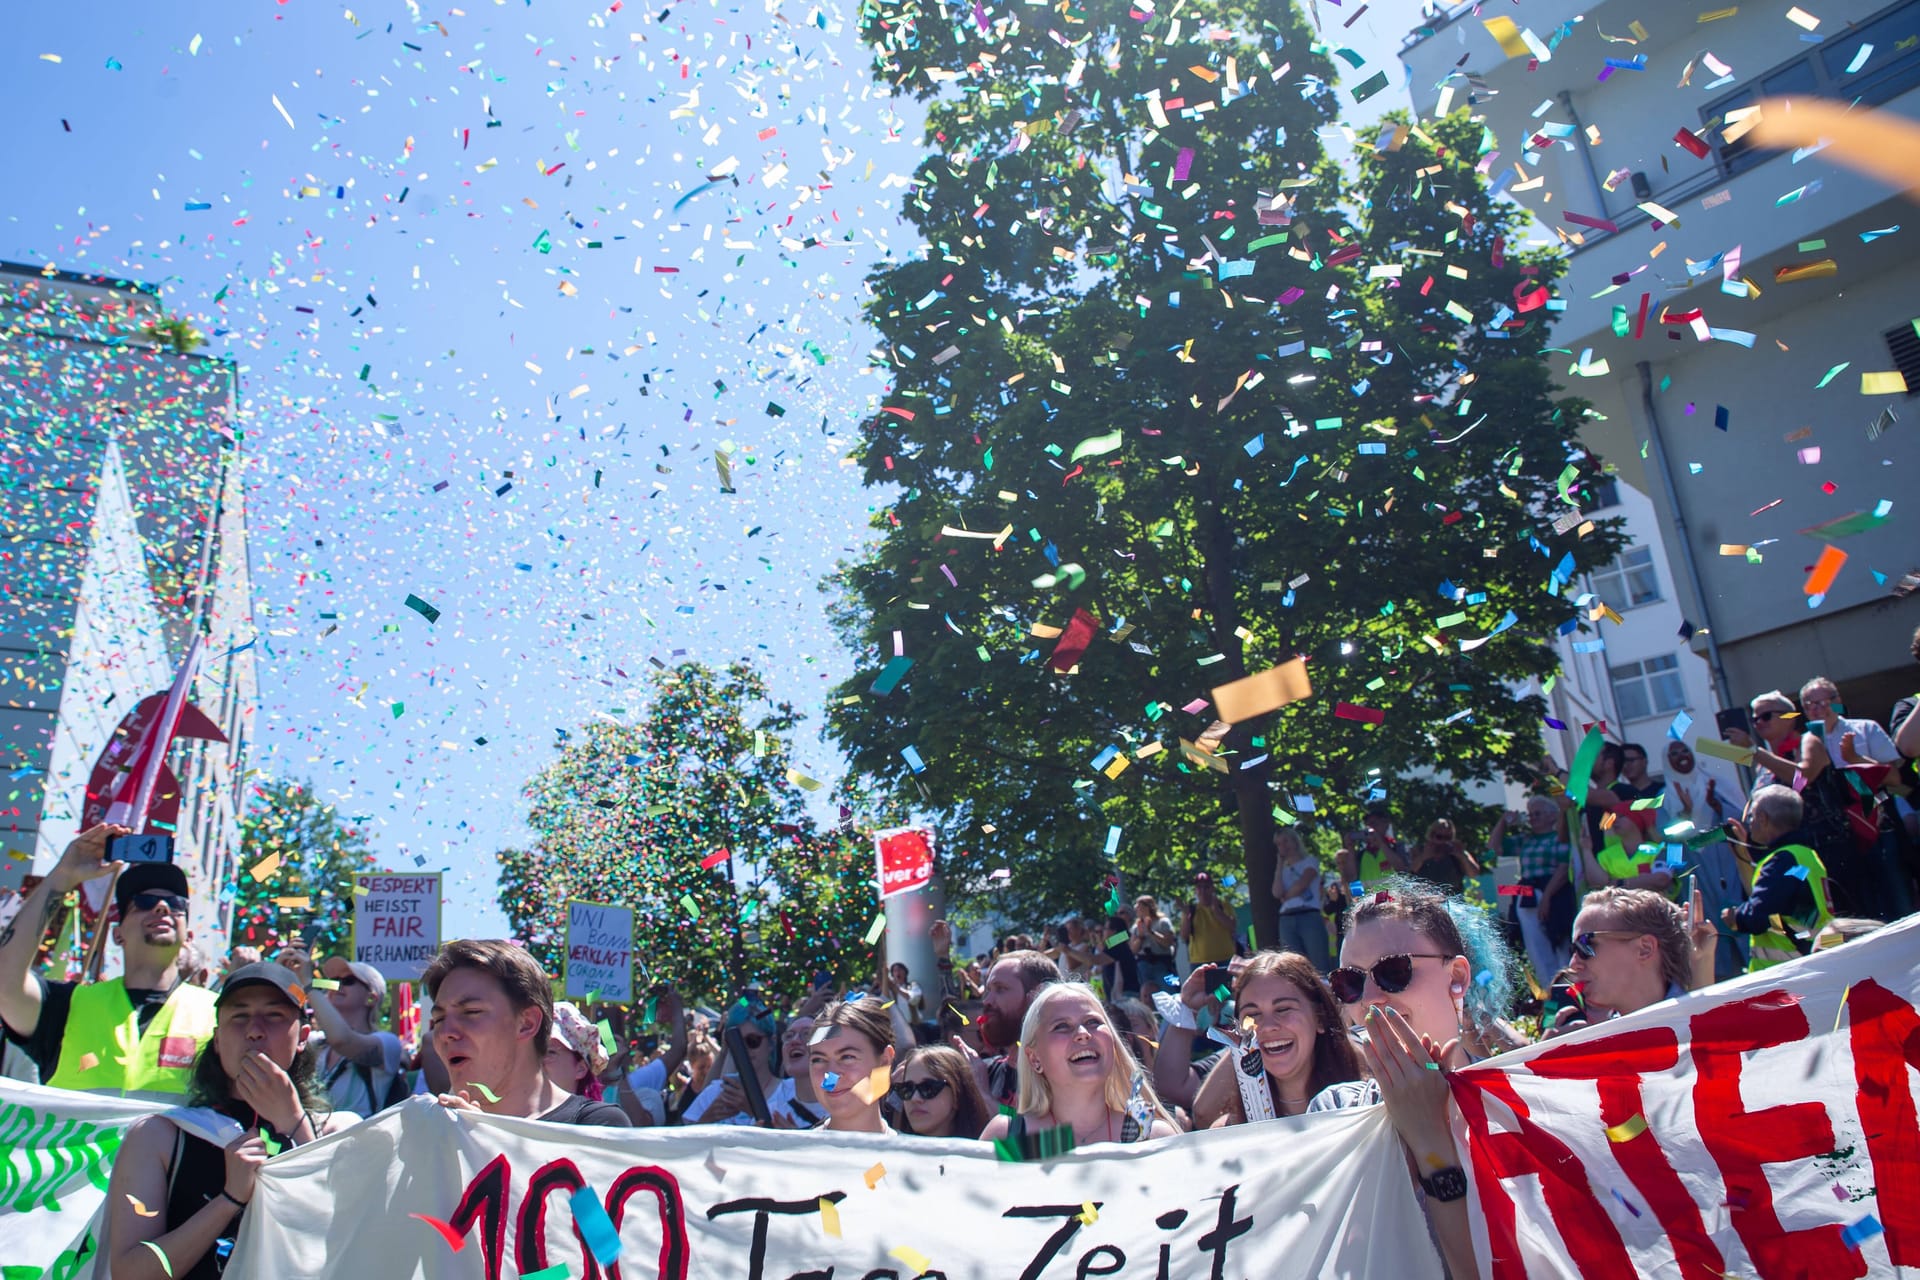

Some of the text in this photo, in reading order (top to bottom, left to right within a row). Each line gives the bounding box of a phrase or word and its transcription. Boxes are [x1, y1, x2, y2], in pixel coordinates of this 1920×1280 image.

[884, 862, 932, 883] ver.d
[359, 876, 438, 893] RESPEKT
[365, 899, 421, 912] HEISST
[372, 916, 424, 937] FAIR
[571, 907, 605, 928] UNI
[587, 928, 630, 948] BONN
[568, 944, 630, 967] VERKLAGT
[449, 1153, 691, 1280] 100
